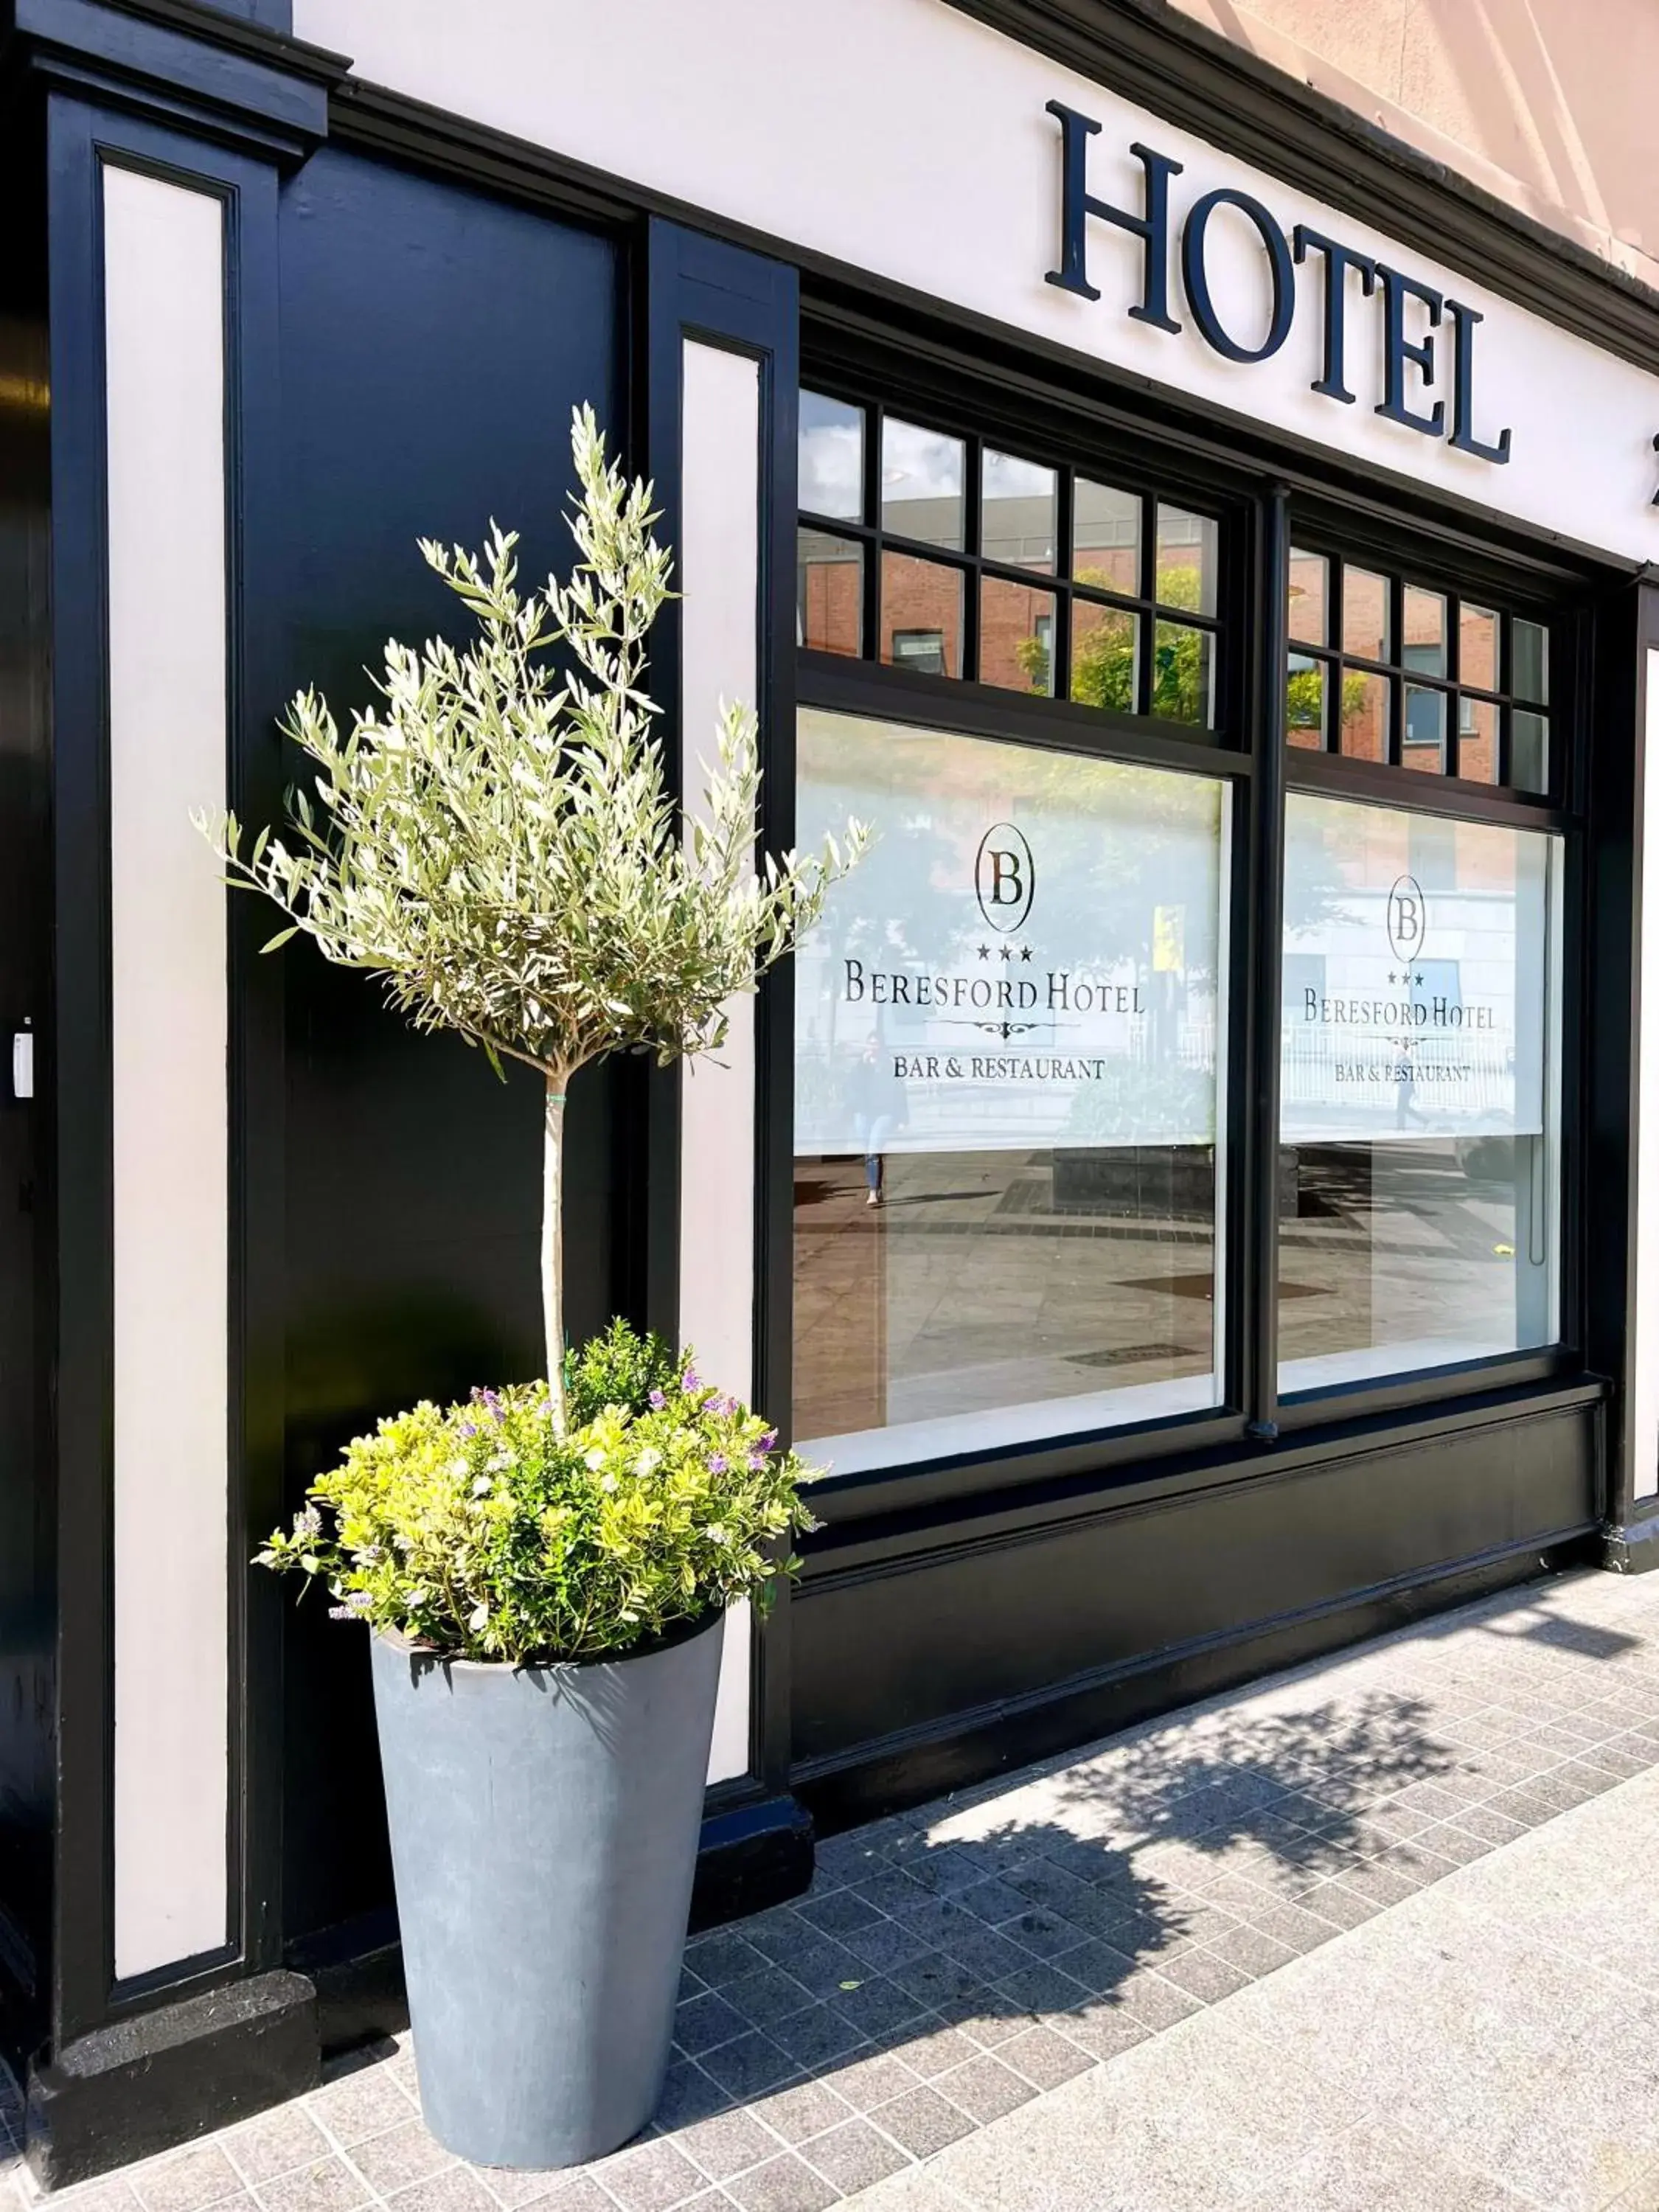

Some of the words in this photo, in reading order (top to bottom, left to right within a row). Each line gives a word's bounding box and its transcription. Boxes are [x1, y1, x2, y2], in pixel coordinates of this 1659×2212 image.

[1045, 99, 1512, 465] HOTEL
[987, 850, 1023, 905] B
[1395, 897, 1419, 941] B
[844, 959, 1037, 1009] BERESFORD
[1046, 973, 1145, 1014] HOTEL
[1304, 987, 1427, 1026] BERESFORD
[1433, 997, 1497, 1029] HOTEL
[894, 1057, 939, 1079] BAR
[945, 1057, 961, 1079] &
[971, 1057, 1106, 1080] RESTAURANT
[1335, 1065, 1365, 1082] BAR
[1368, 1066, 1381, 1082] &
[1385, 1065, 1472, 1082] RESTAURANT
